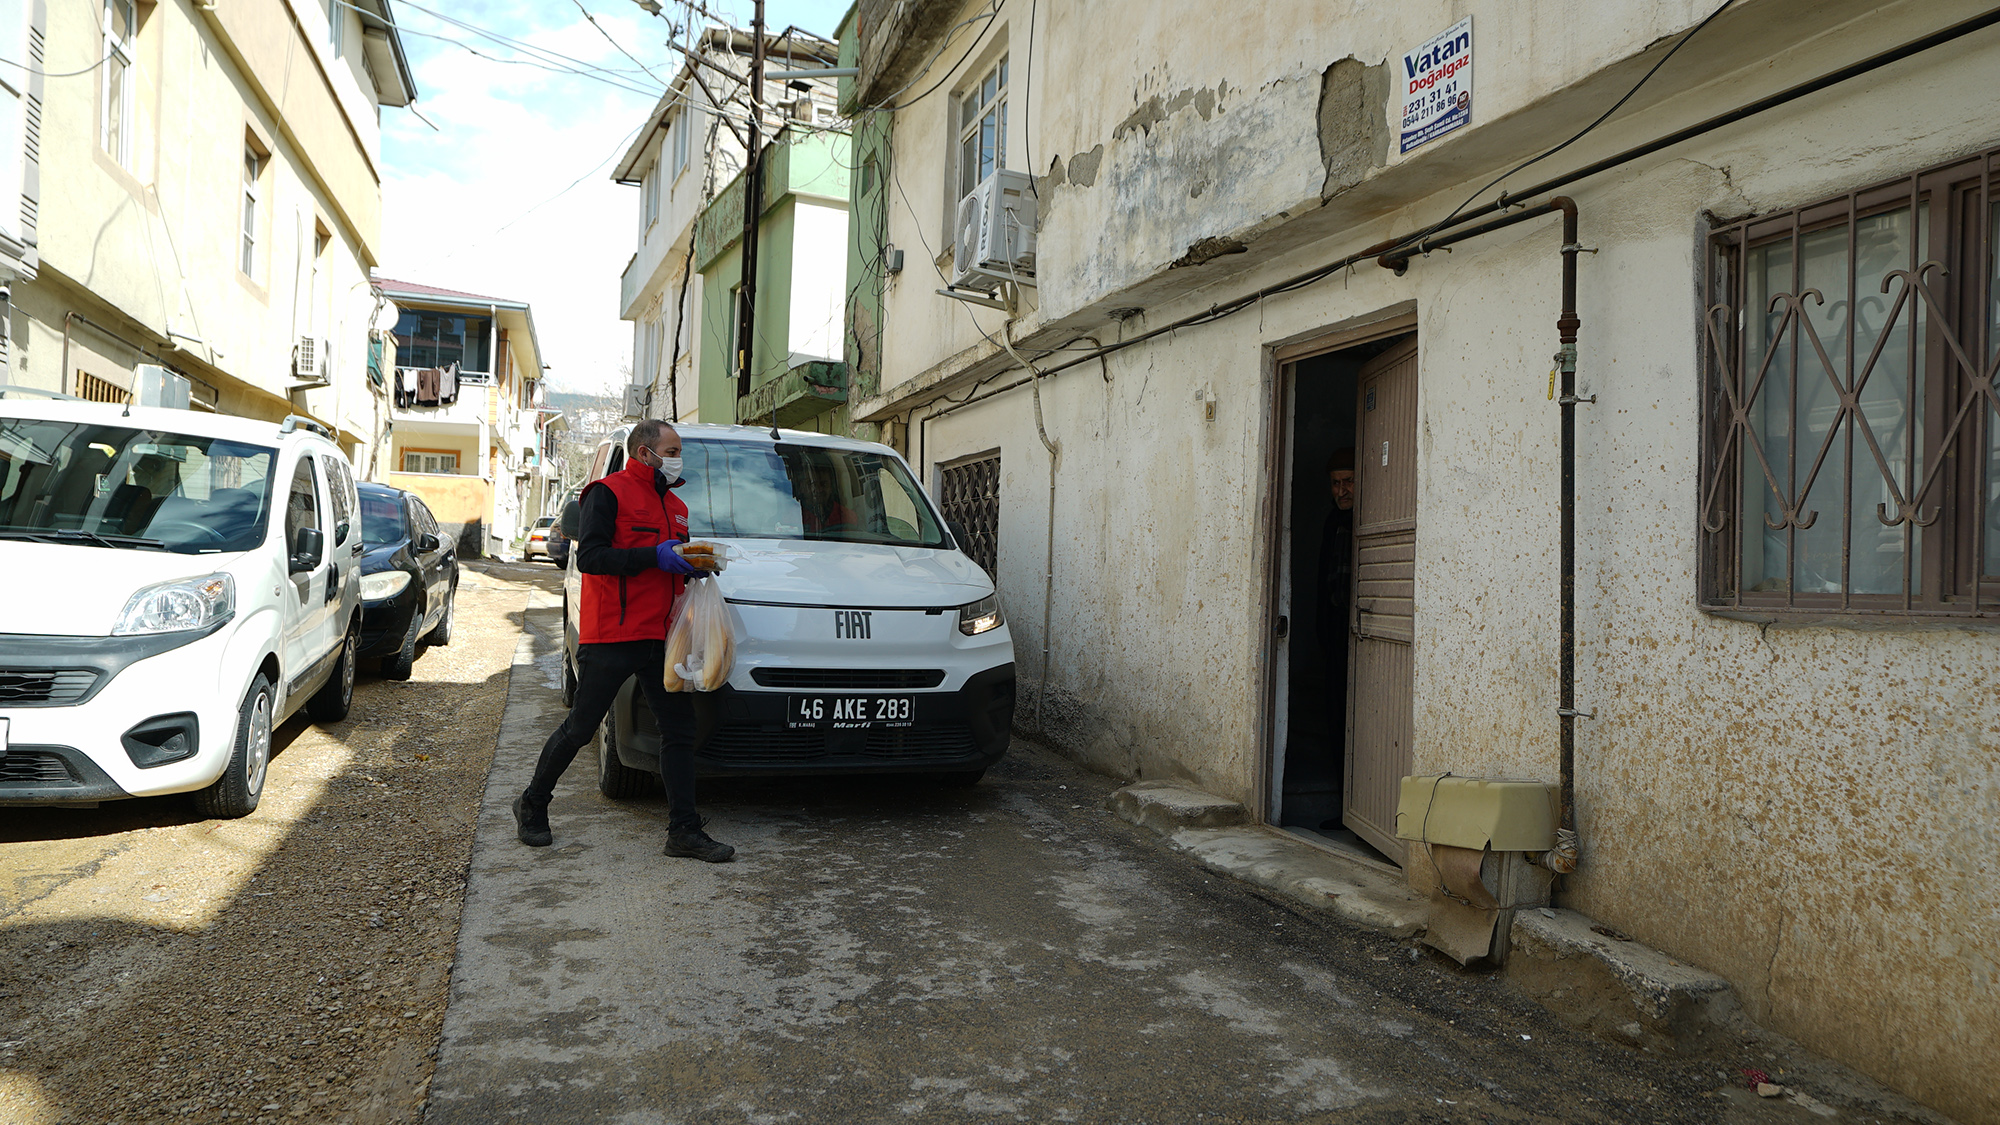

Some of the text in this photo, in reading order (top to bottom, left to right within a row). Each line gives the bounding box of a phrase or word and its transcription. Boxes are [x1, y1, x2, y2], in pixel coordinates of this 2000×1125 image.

[1404, 32, 1469, 79] Vatan
[1409, 54, 1469, 95] Doğalgaz
[1408, 96, 1425, 114] 231
[1429, 88, 1441, 103] 31
[1445, 80, 1457, 94] 41
[1402, 112, 1420, 129] 0544
[1421, 105, 1434, 120] 211
[1436, 99, 1446, 112] 86
[835, 611, 872, 639] FIAT
[800, 699, 910, 719] 46 AKE 283
